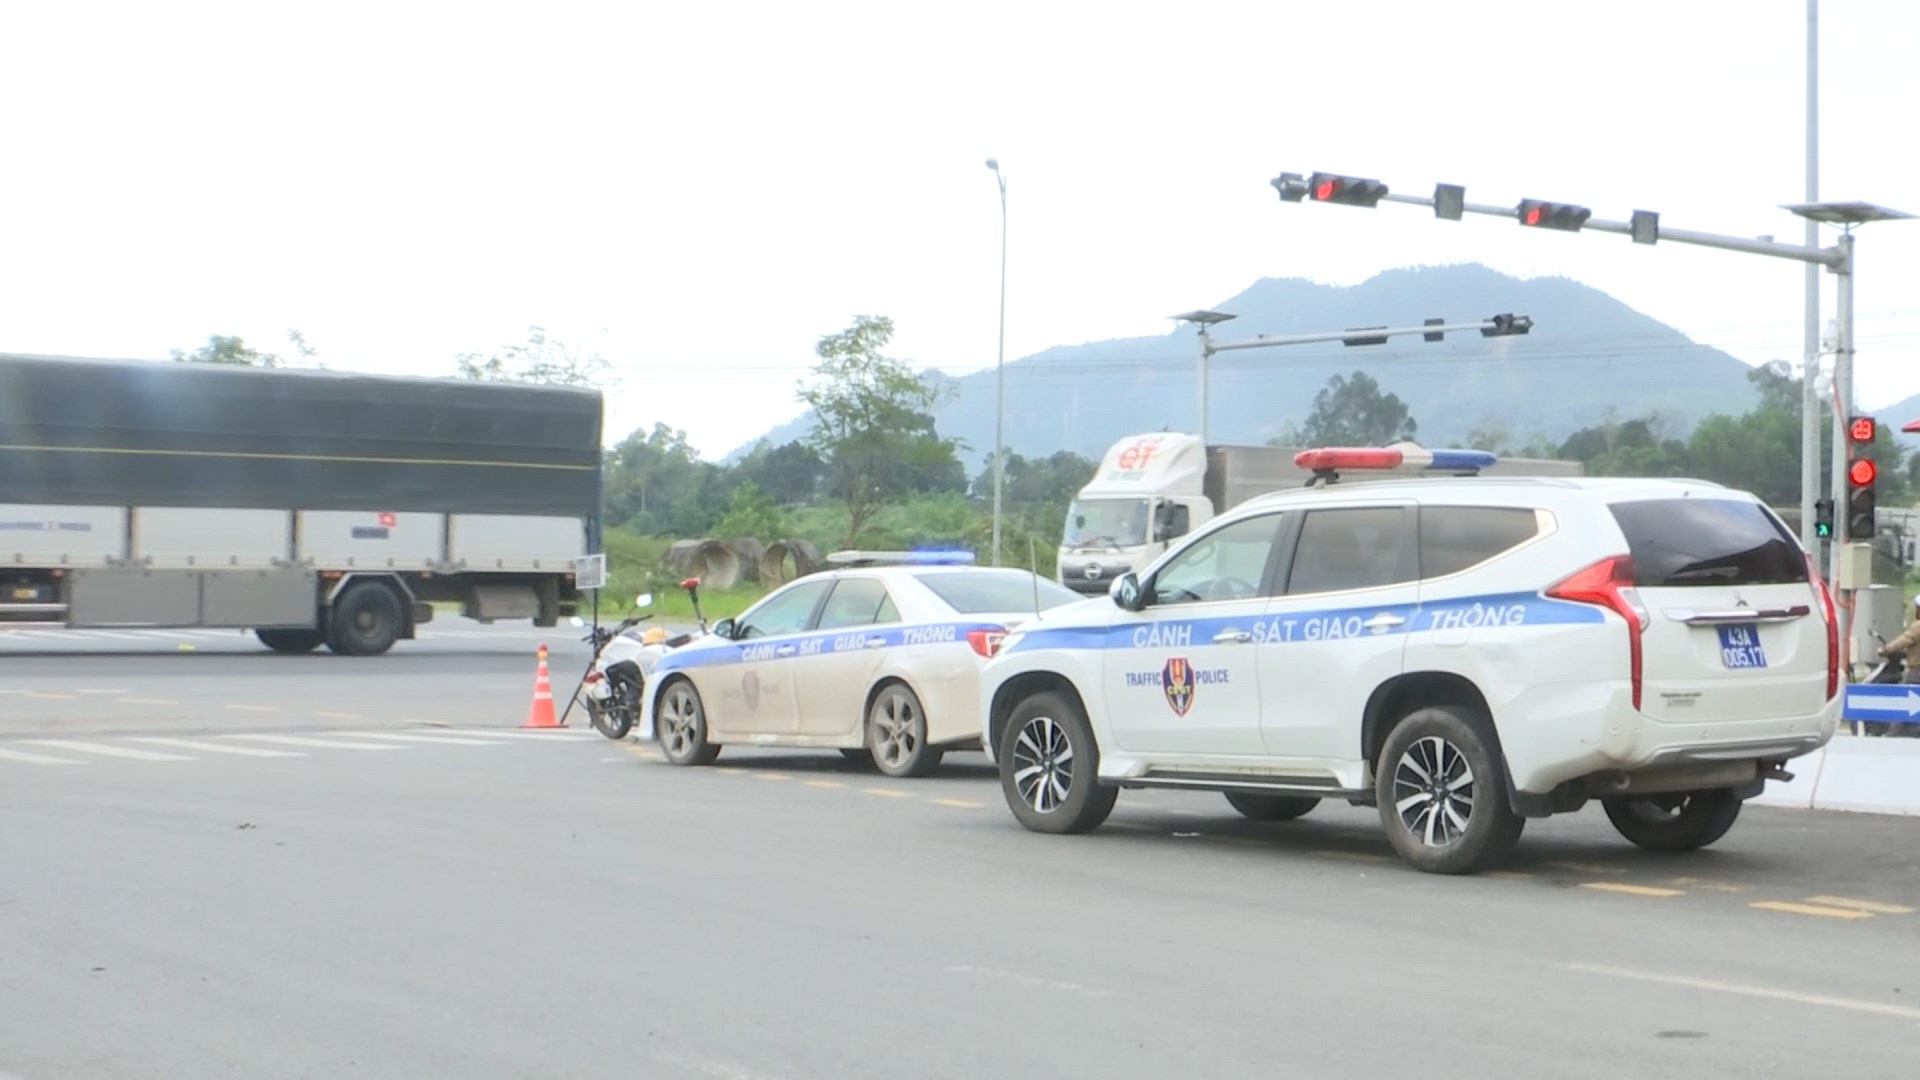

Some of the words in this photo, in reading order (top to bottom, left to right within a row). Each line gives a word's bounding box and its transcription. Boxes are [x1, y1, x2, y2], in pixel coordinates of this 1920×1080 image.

[1251, 616, 1298, 644] SÁT
[1304, 615, 1362, 642] GIAO
[1430, 602, 1527, 629] THÔNG
[834, 632, 866, 652] GIAO
[1727, 628, 1752, 647] 43A
[1723, 646, 1765, 667] 005.17
[1126, 672, 1162, 686] TRAFFIC
[1195, 669, 1230, 684] POLICE
